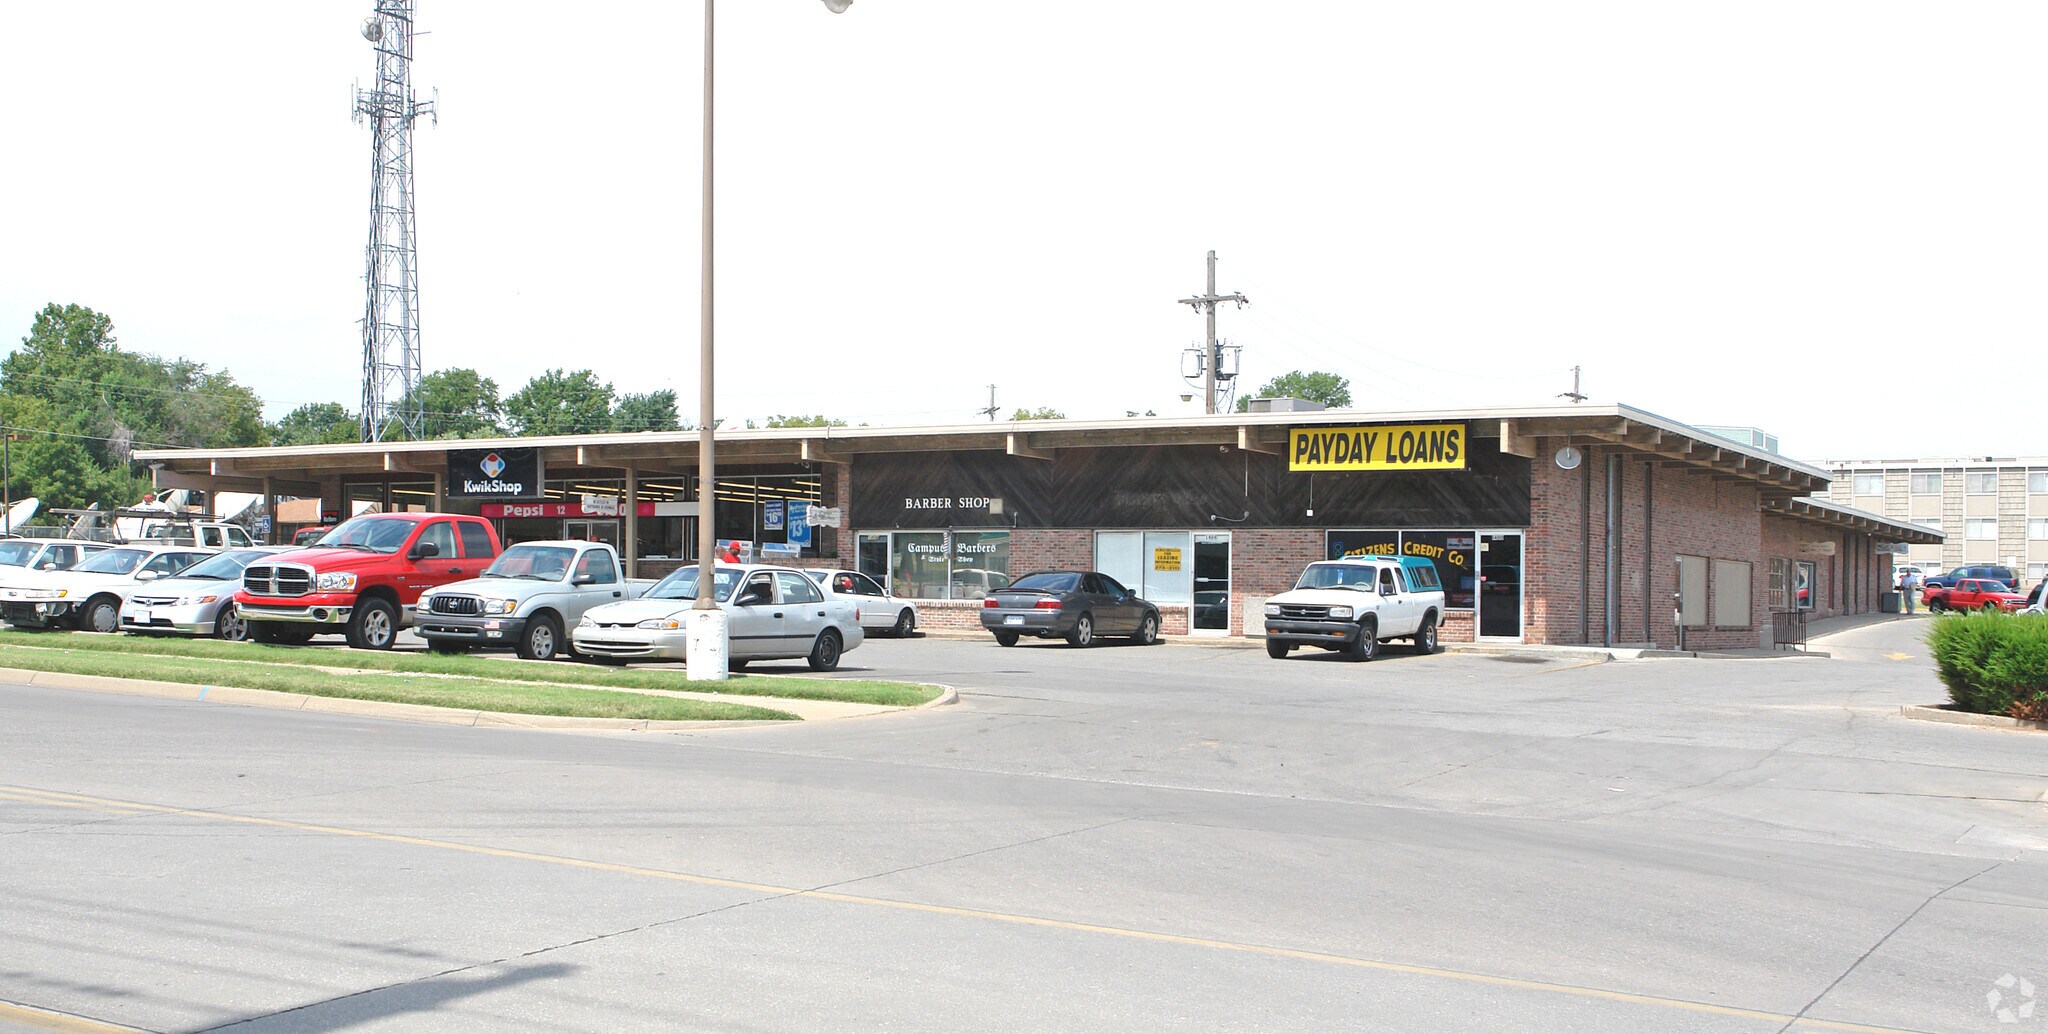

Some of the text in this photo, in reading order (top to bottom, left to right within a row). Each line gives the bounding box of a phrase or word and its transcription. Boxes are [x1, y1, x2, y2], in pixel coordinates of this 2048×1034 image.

[1295, 429, 1460, 465] PAYDAY LOANS
[464, 480, 522, 495] KwikShop
[905, 497, 990, 509] BARBER SHOP
[503, 505, 566, 517] Pepsi 12
[908, 543, 996, 554] Campus Barbers
[1404, 541, 1444, 559] CREDIT
